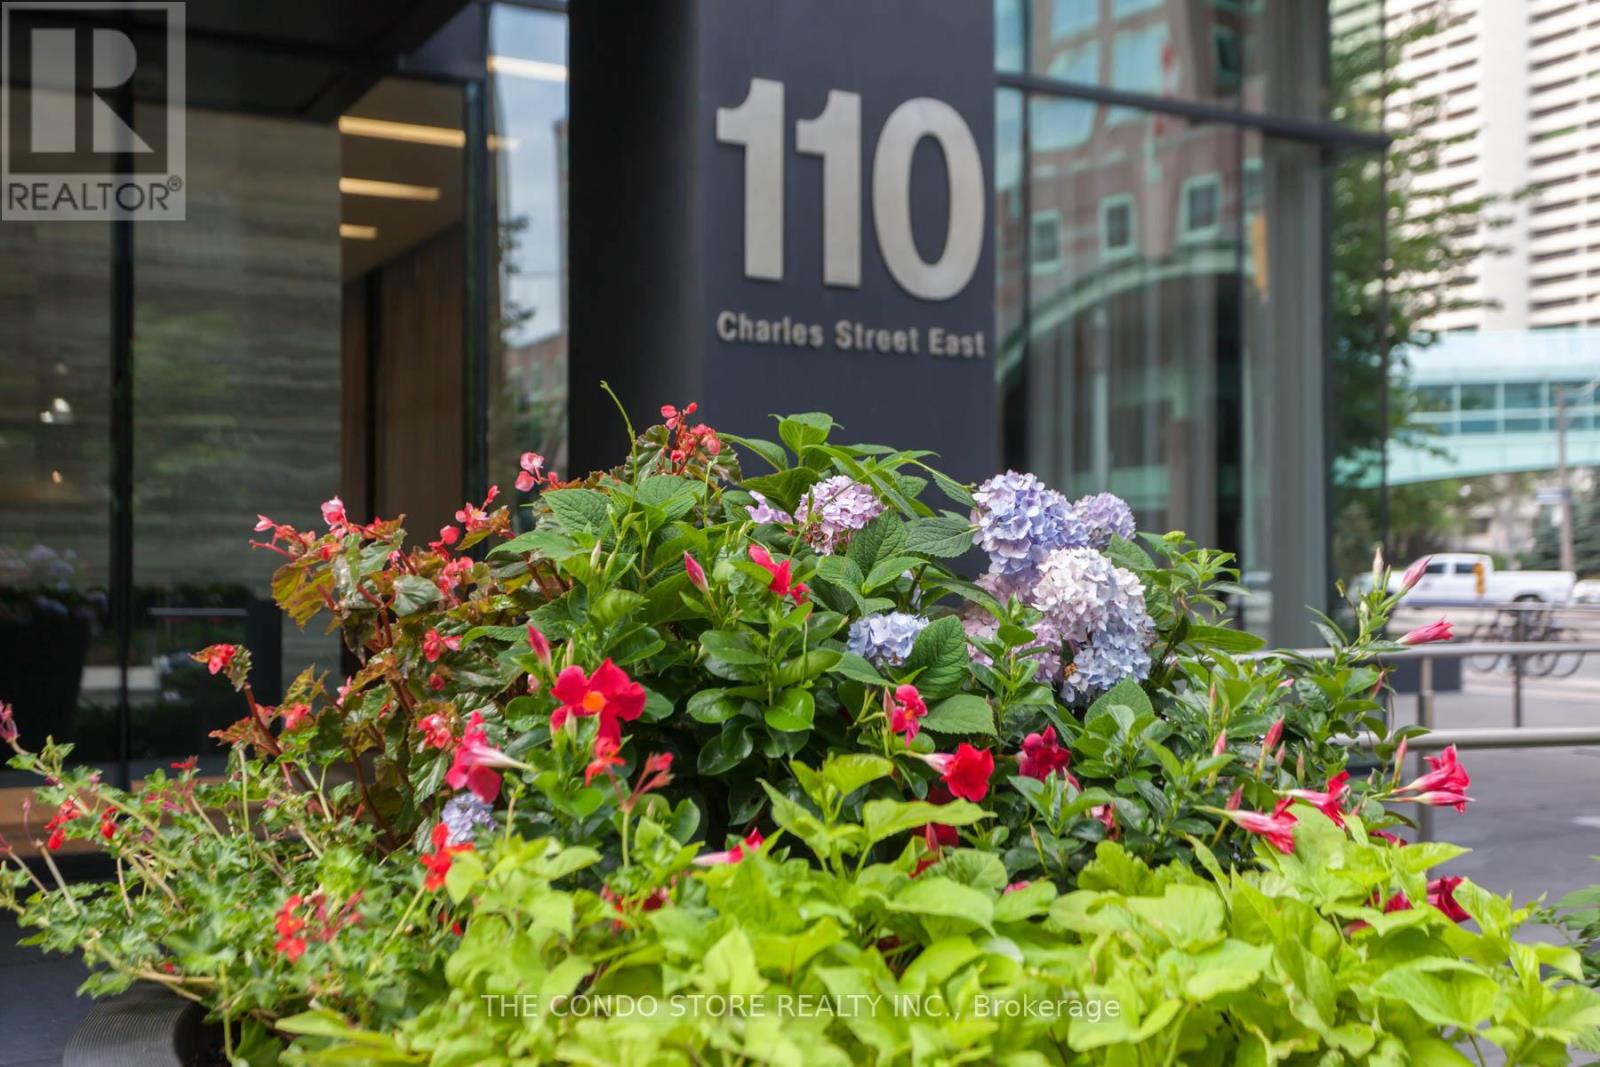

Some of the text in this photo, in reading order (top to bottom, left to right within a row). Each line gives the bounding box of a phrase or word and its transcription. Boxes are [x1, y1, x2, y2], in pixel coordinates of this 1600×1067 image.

[716, 77, 985, 301] 110
[716, 310, 986, 358] Charles Street East
